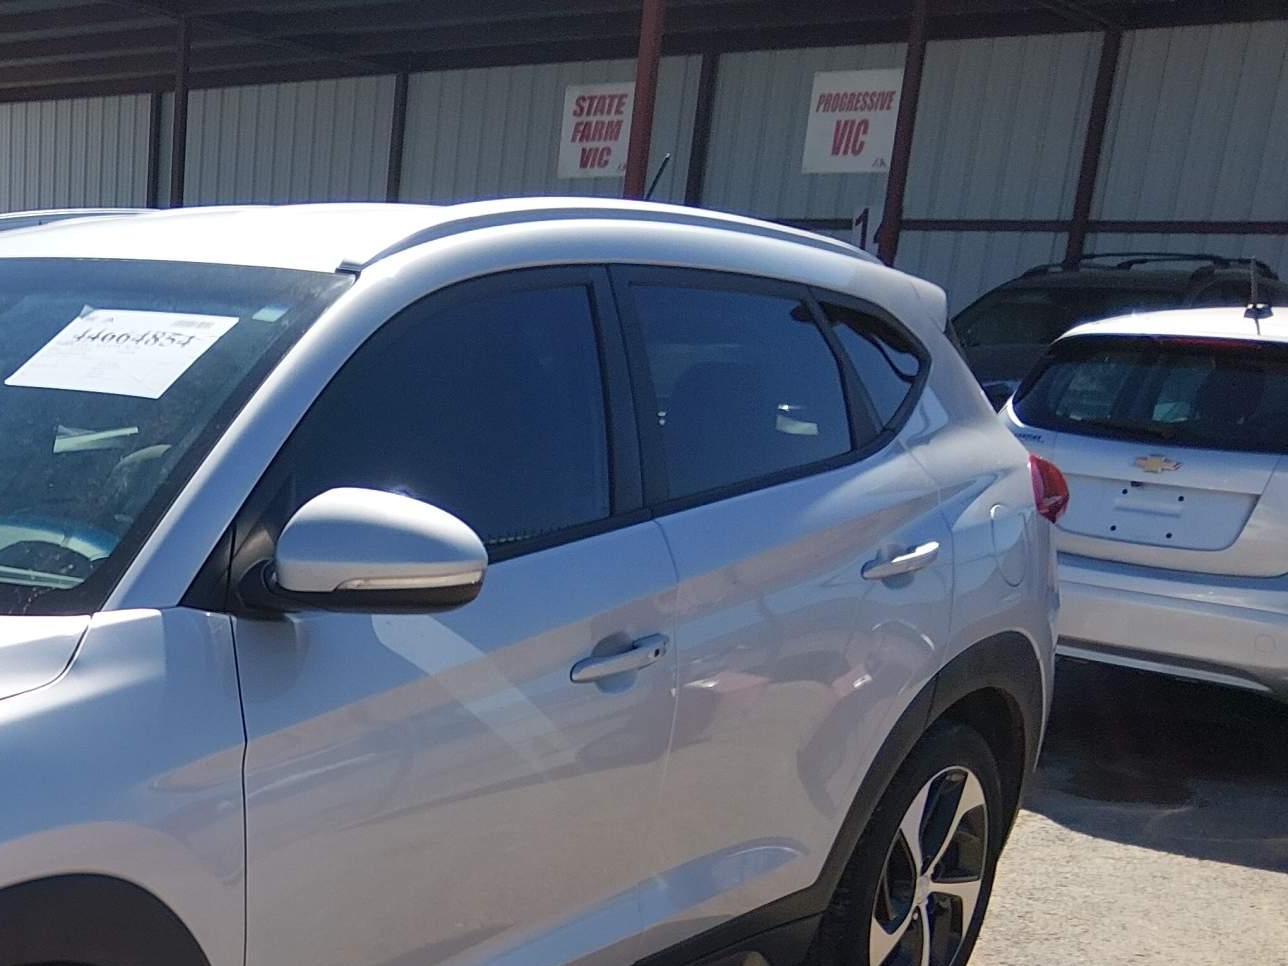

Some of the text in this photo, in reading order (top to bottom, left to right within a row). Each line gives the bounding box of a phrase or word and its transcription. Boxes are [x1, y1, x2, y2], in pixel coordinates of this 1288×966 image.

[573, 93, 628, 117] STATE
[815, 90, 896, 113] PROGRESSIVE
[571, 120, 624, 143] FARM
[831, 118, 869, 157] VIC
[579, 146, 612, 169] VIC
